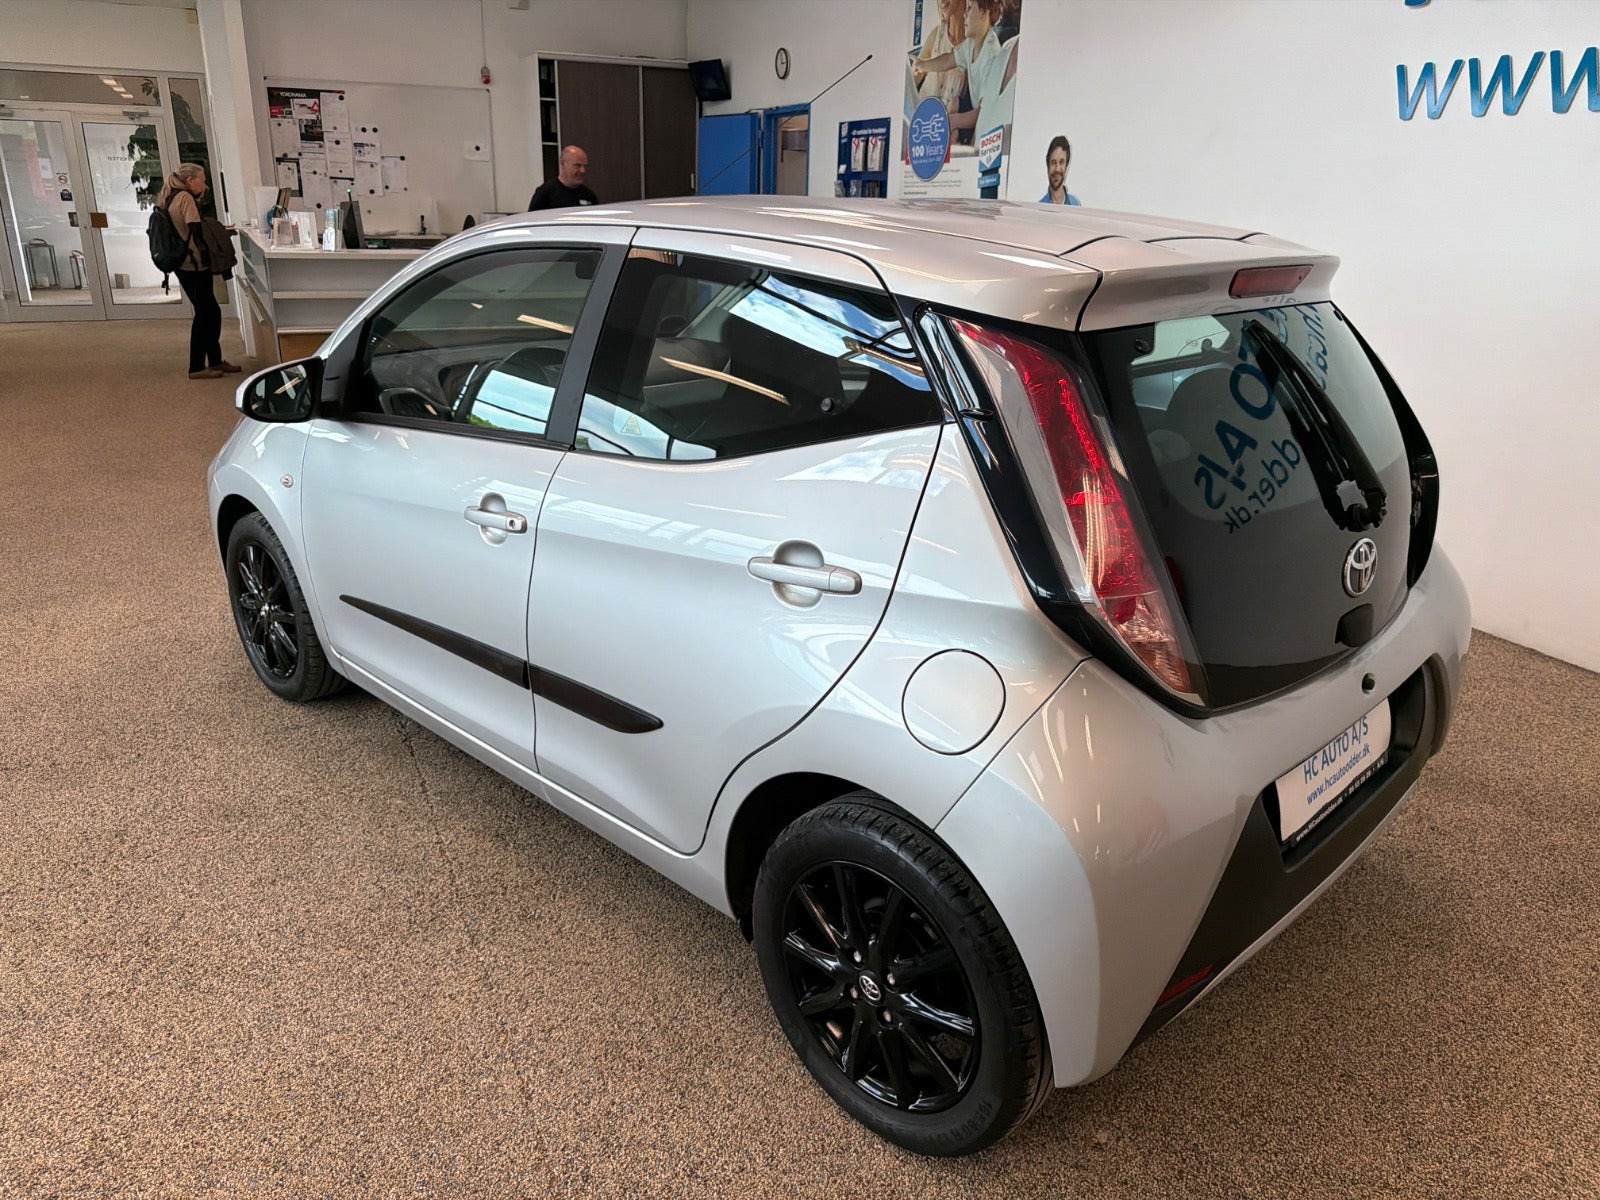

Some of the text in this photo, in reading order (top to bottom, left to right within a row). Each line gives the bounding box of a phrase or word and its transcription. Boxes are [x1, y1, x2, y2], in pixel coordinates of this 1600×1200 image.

[911, 145, 944, 158] 100 Years
[981, 132, 1002, 148] BOSCH
[1303, 755, 1319, 784] HC
[1321, 732, 1350, 770] AUTO
[1352, 716, 1369, 745] A/S
[1306, 743, 1371, 805] www.hcautoodder.dk
